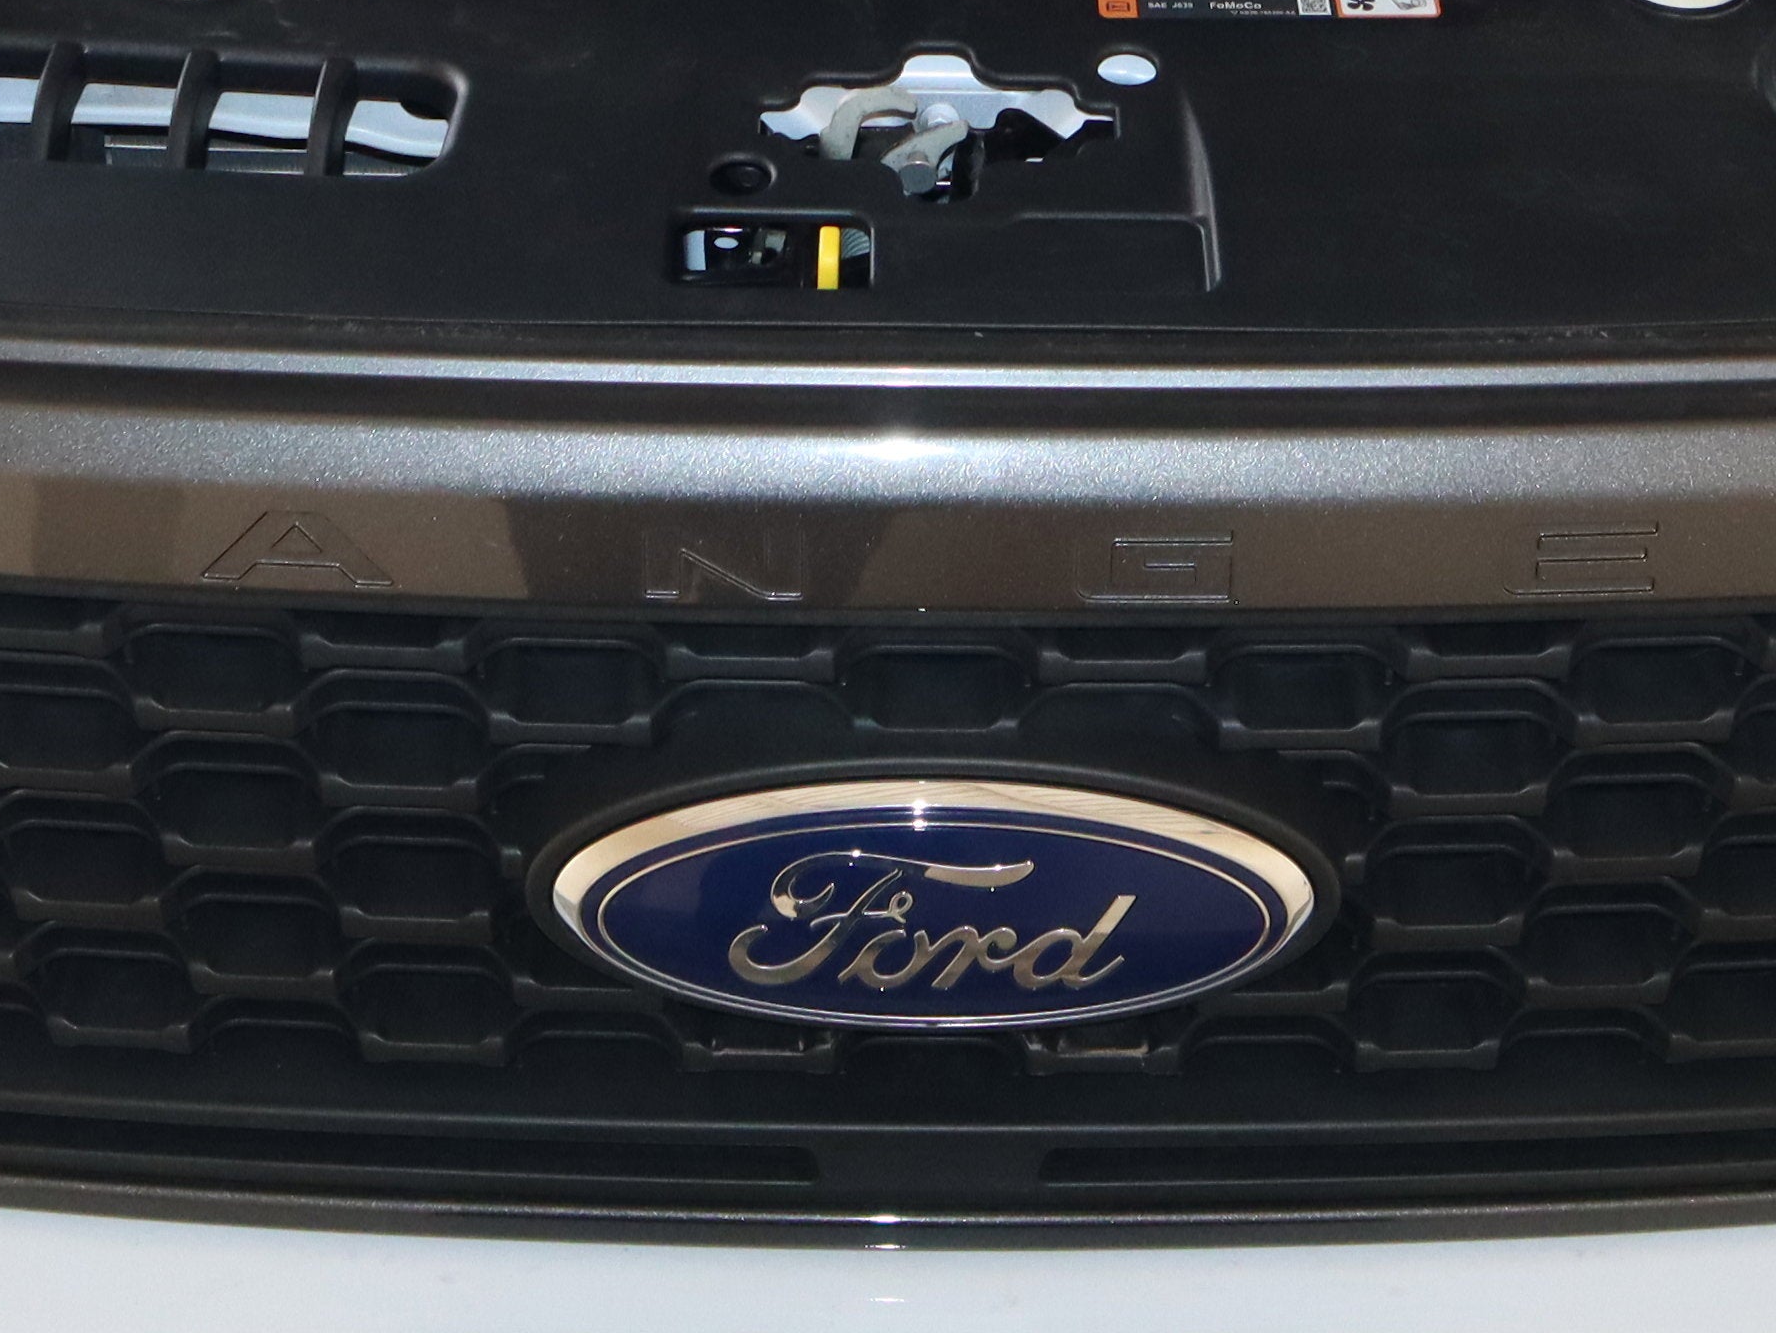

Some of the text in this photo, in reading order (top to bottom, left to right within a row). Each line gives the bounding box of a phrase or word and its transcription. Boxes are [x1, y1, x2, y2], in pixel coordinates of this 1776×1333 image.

[1147, 1, 1167, 9] SAE
[1209, 0, 1262, 10] FoMoCo
[727, 849, 1138, 992] Ford
